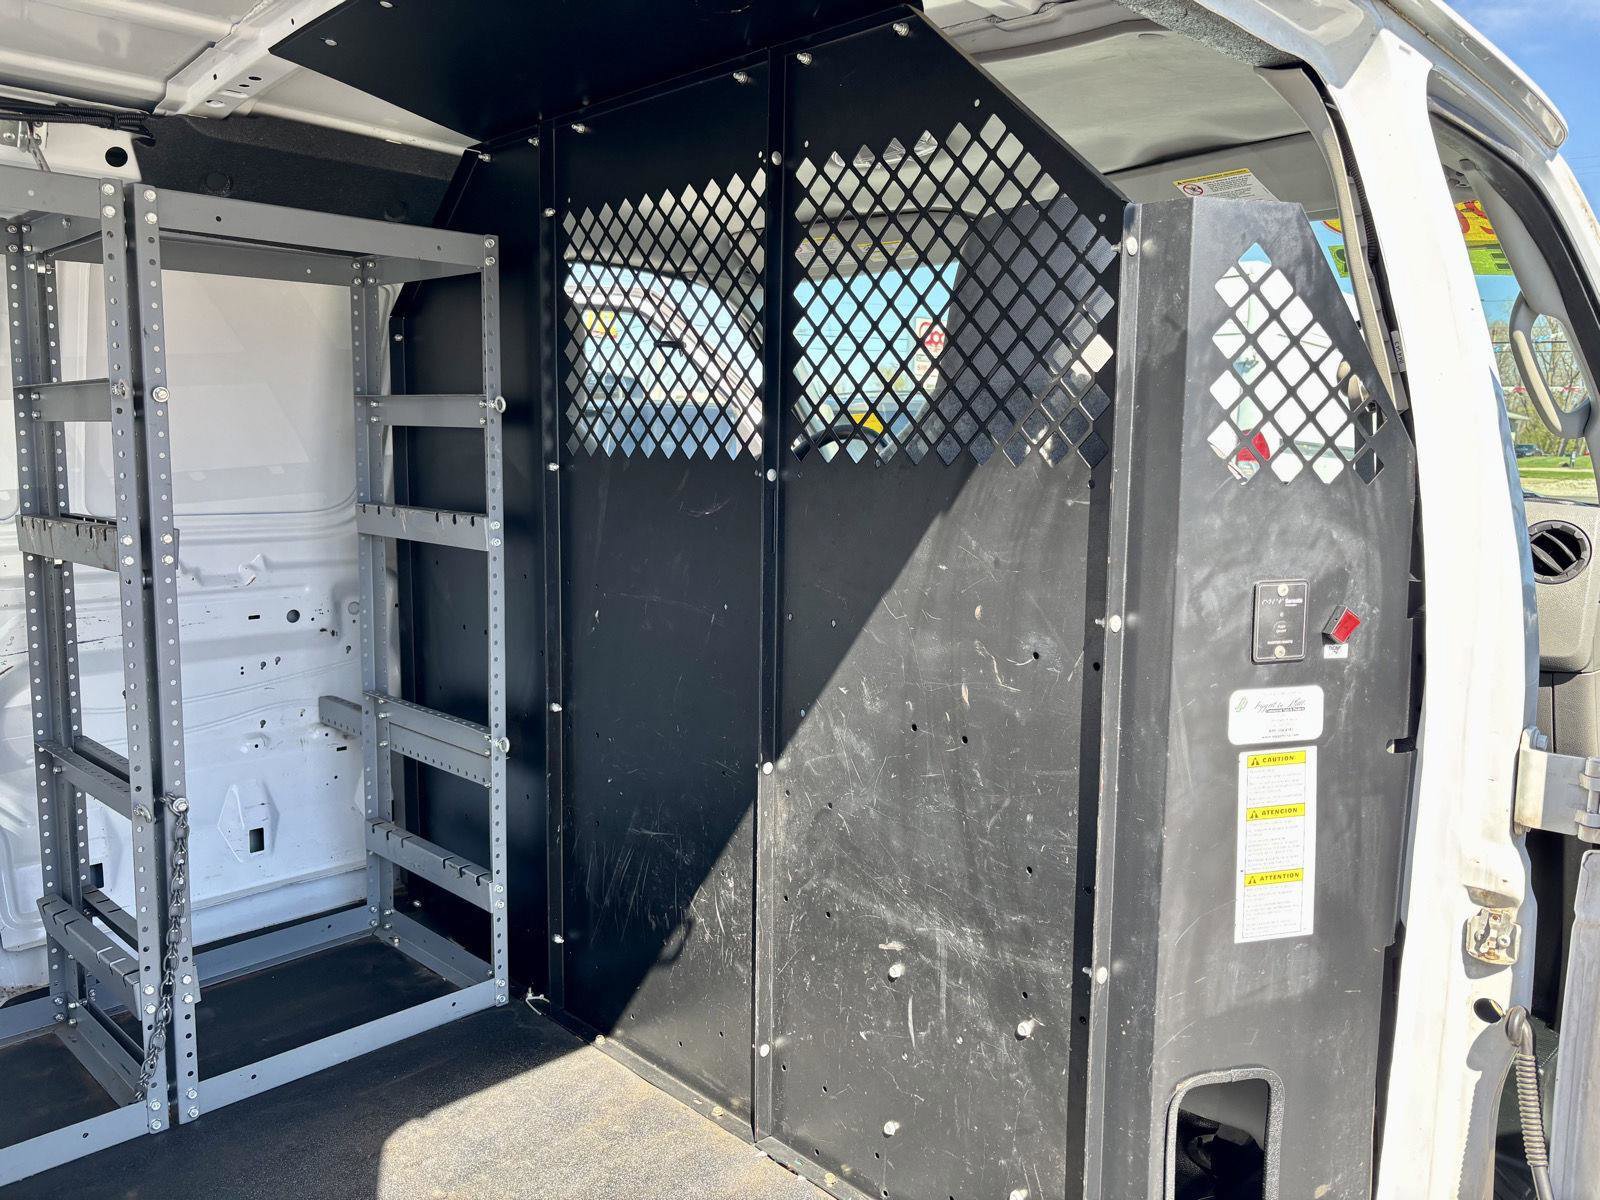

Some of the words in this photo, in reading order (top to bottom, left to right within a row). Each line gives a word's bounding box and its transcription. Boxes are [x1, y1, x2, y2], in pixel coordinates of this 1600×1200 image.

[1262, 755, 1295, 763] CAUTION
[1261, 807, 1298, 816] ATENCION
[1259, 872, 1300, 881] ATTENTION
